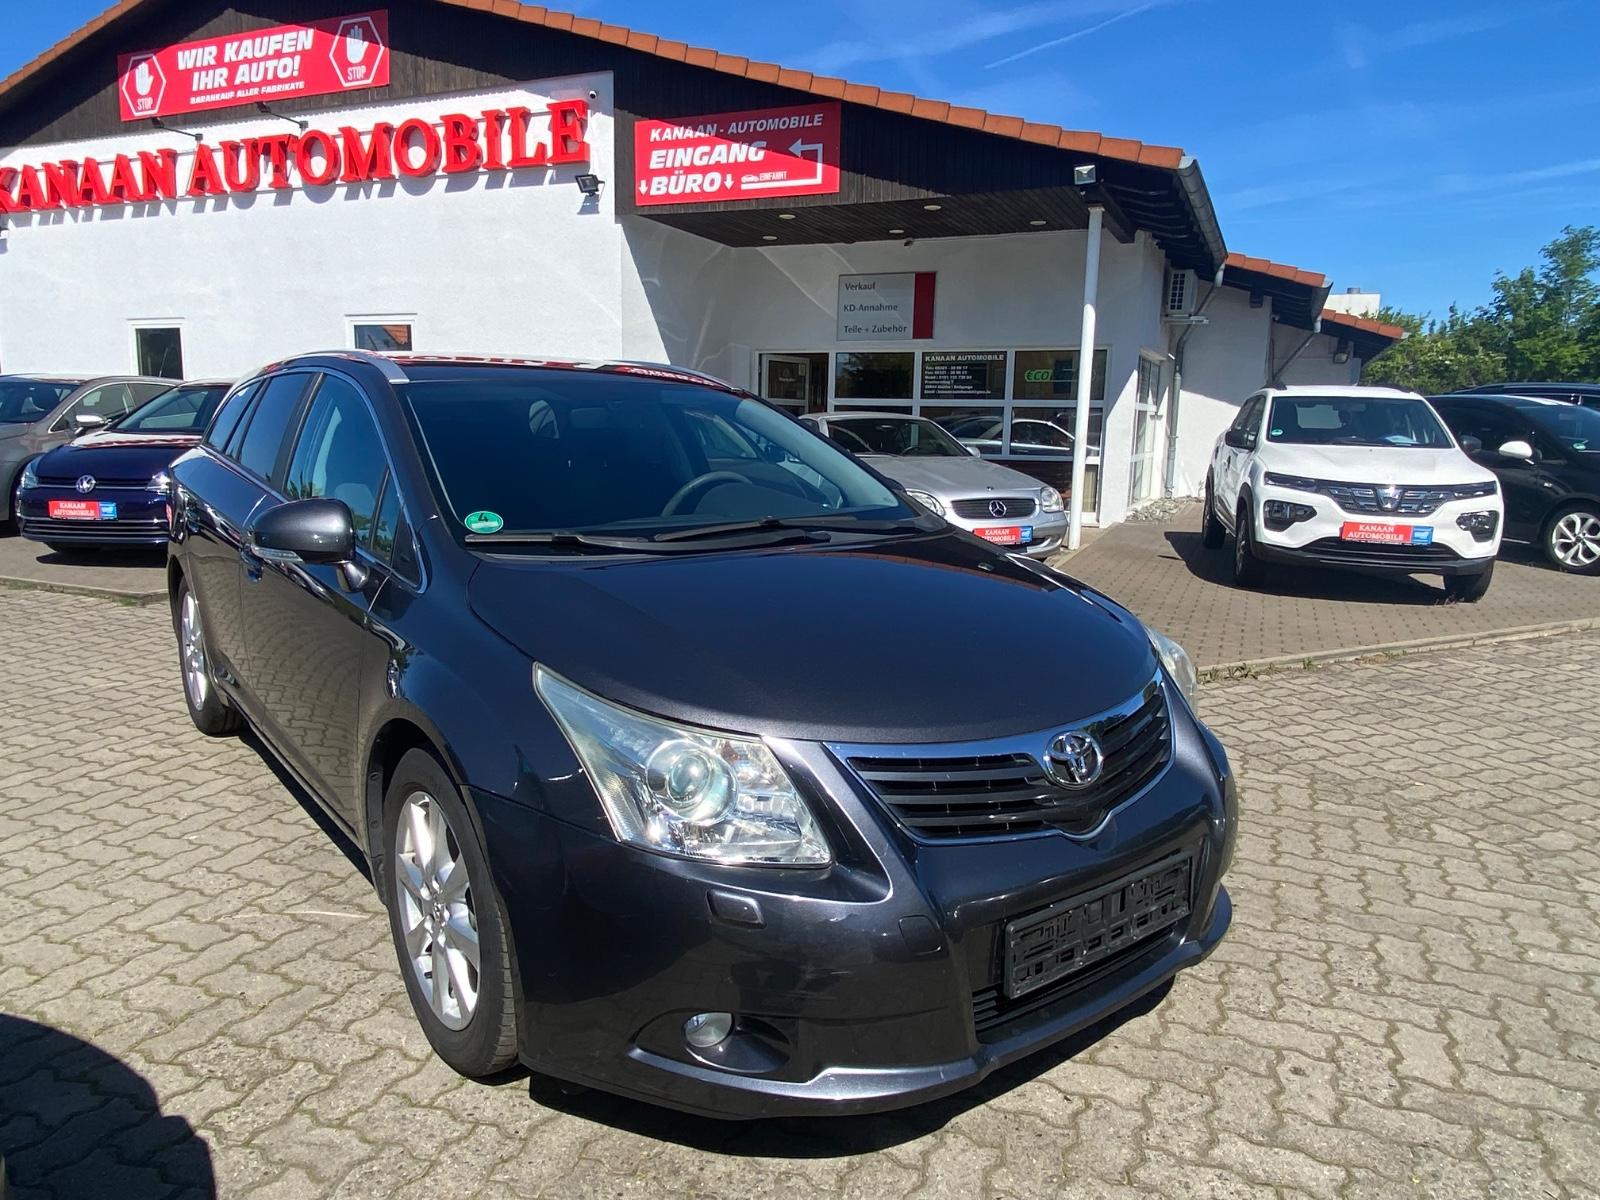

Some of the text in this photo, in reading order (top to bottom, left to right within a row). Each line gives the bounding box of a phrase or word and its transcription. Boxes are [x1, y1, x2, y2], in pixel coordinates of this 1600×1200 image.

[177, 28, 315, 71] WIR KAUFEN
[191, 55, 301, 92] IHR AUTO!
[347, 65, 367, 82] STOP
[236, 87, 260, 98] ALLER
[261, 81, 305, 95] FABRIKATE
[136, 97, 154, 112] STOP
[649, 123, 718, 143] KANAAN
[727, 113, 824, 135] AUTOMOBILE
[186, 99, 590, 197] AUTOMOBILE
[649, 141, 767, 170] EINGANG
[649, 170, 722, 196] BÜRO
[758, 171, 788, 181] EINFAHRT
[844, 281, 876, 291] Verkauf
[843, 325, 863, 334] Teile
[871, 324, 908, 334] Zubehör
[477, 512, 489, 523] 4
[1347, 531, 1405, 541] AUTOMOBILE
[1358, 524, 1395, 533] KANAAN
